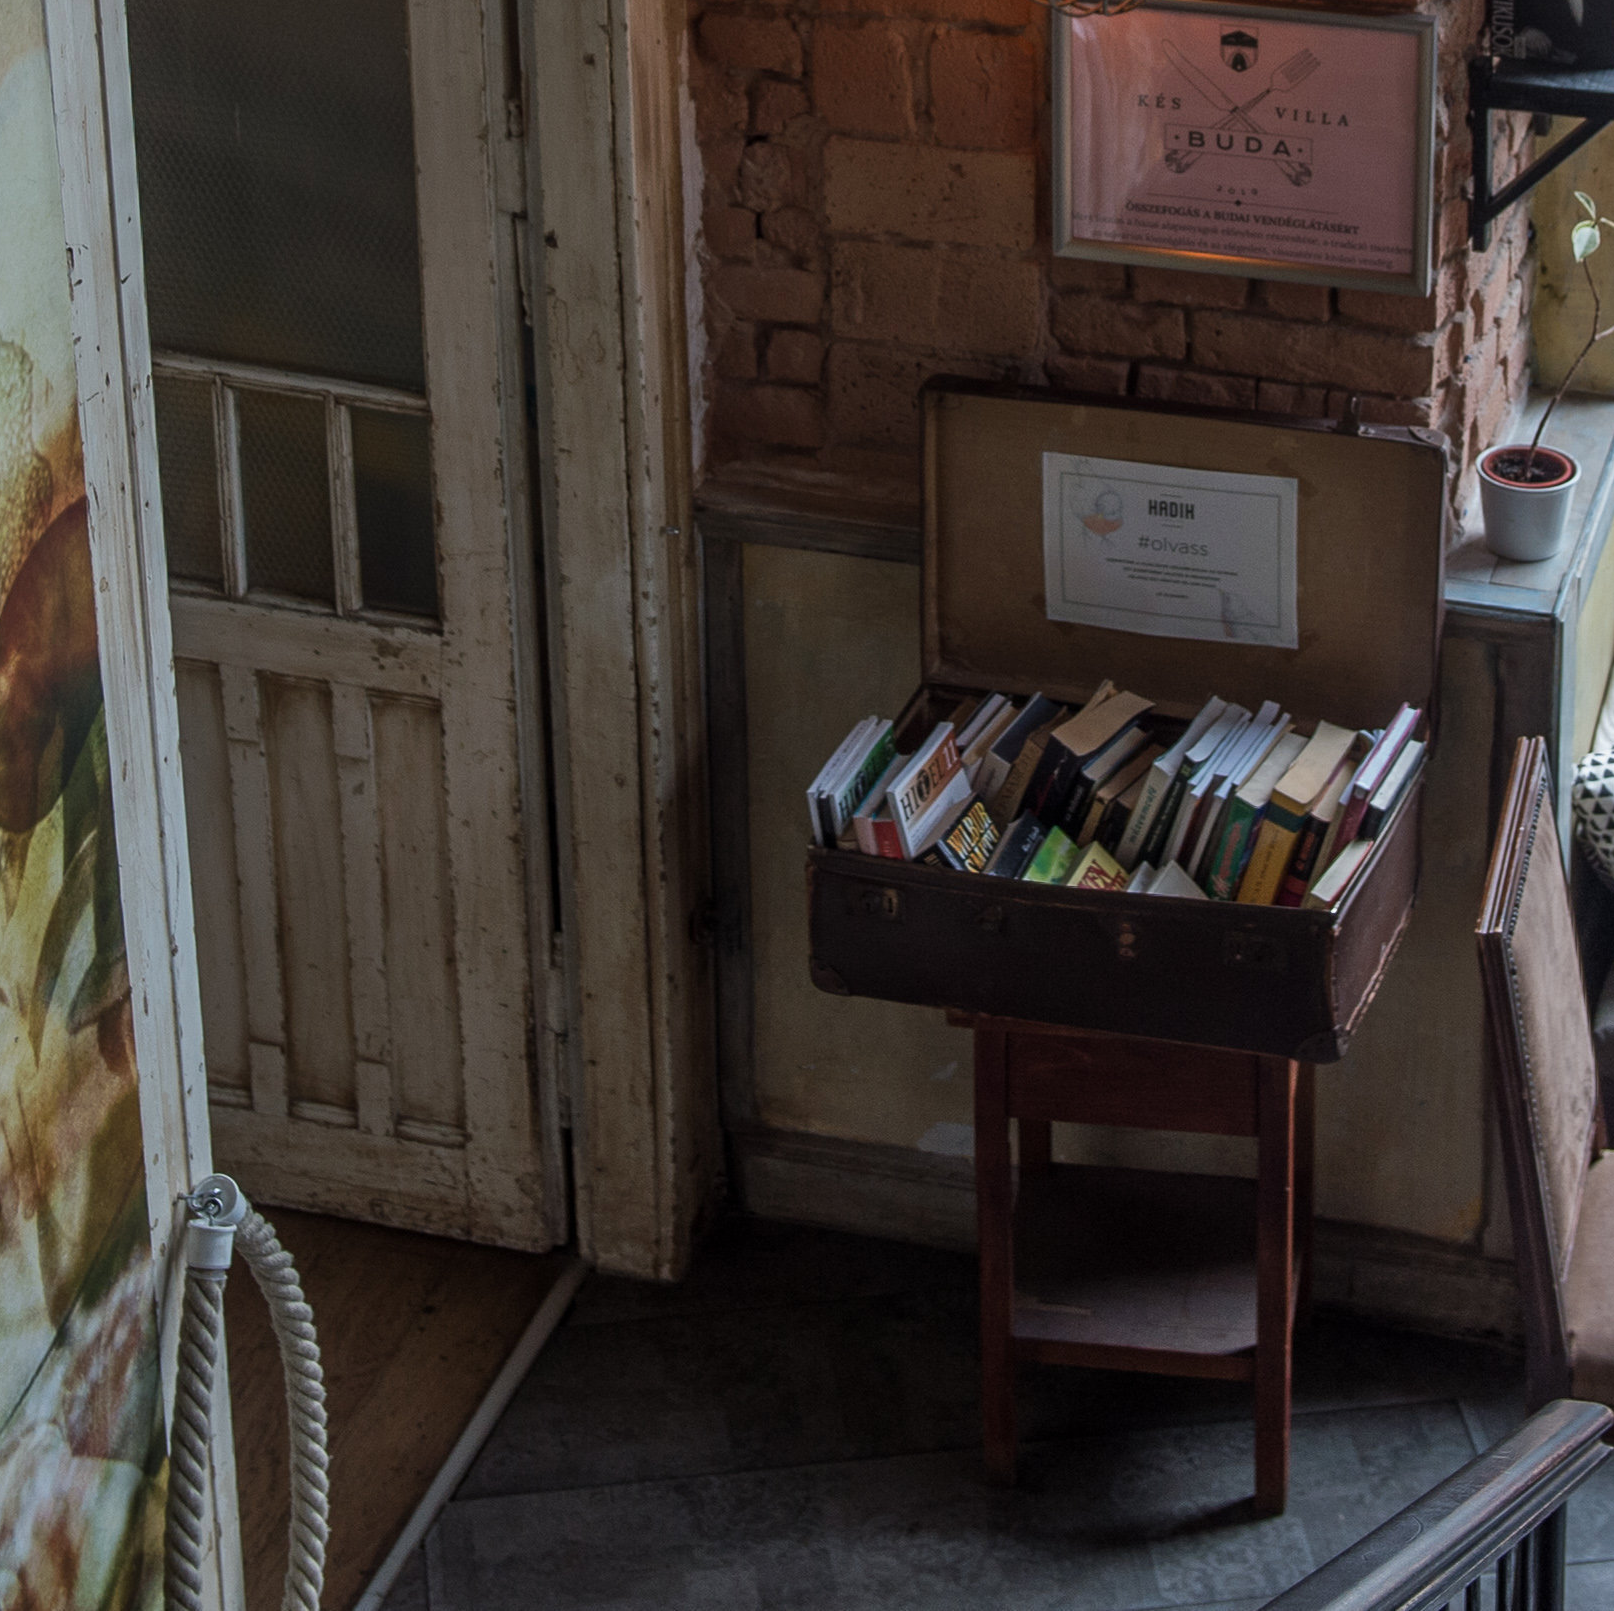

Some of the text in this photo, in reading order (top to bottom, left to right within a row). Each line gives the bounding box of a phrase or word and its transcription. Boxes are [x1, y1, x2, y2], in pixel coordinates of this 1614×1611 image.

[1137, 93, 1349, 127] KÉS VILLA
[1213, 209, 1250, 224] BUDAI
[1148, 498, 1196, 520] HADIK
[1137, 535, 1209, 557] #olvass
